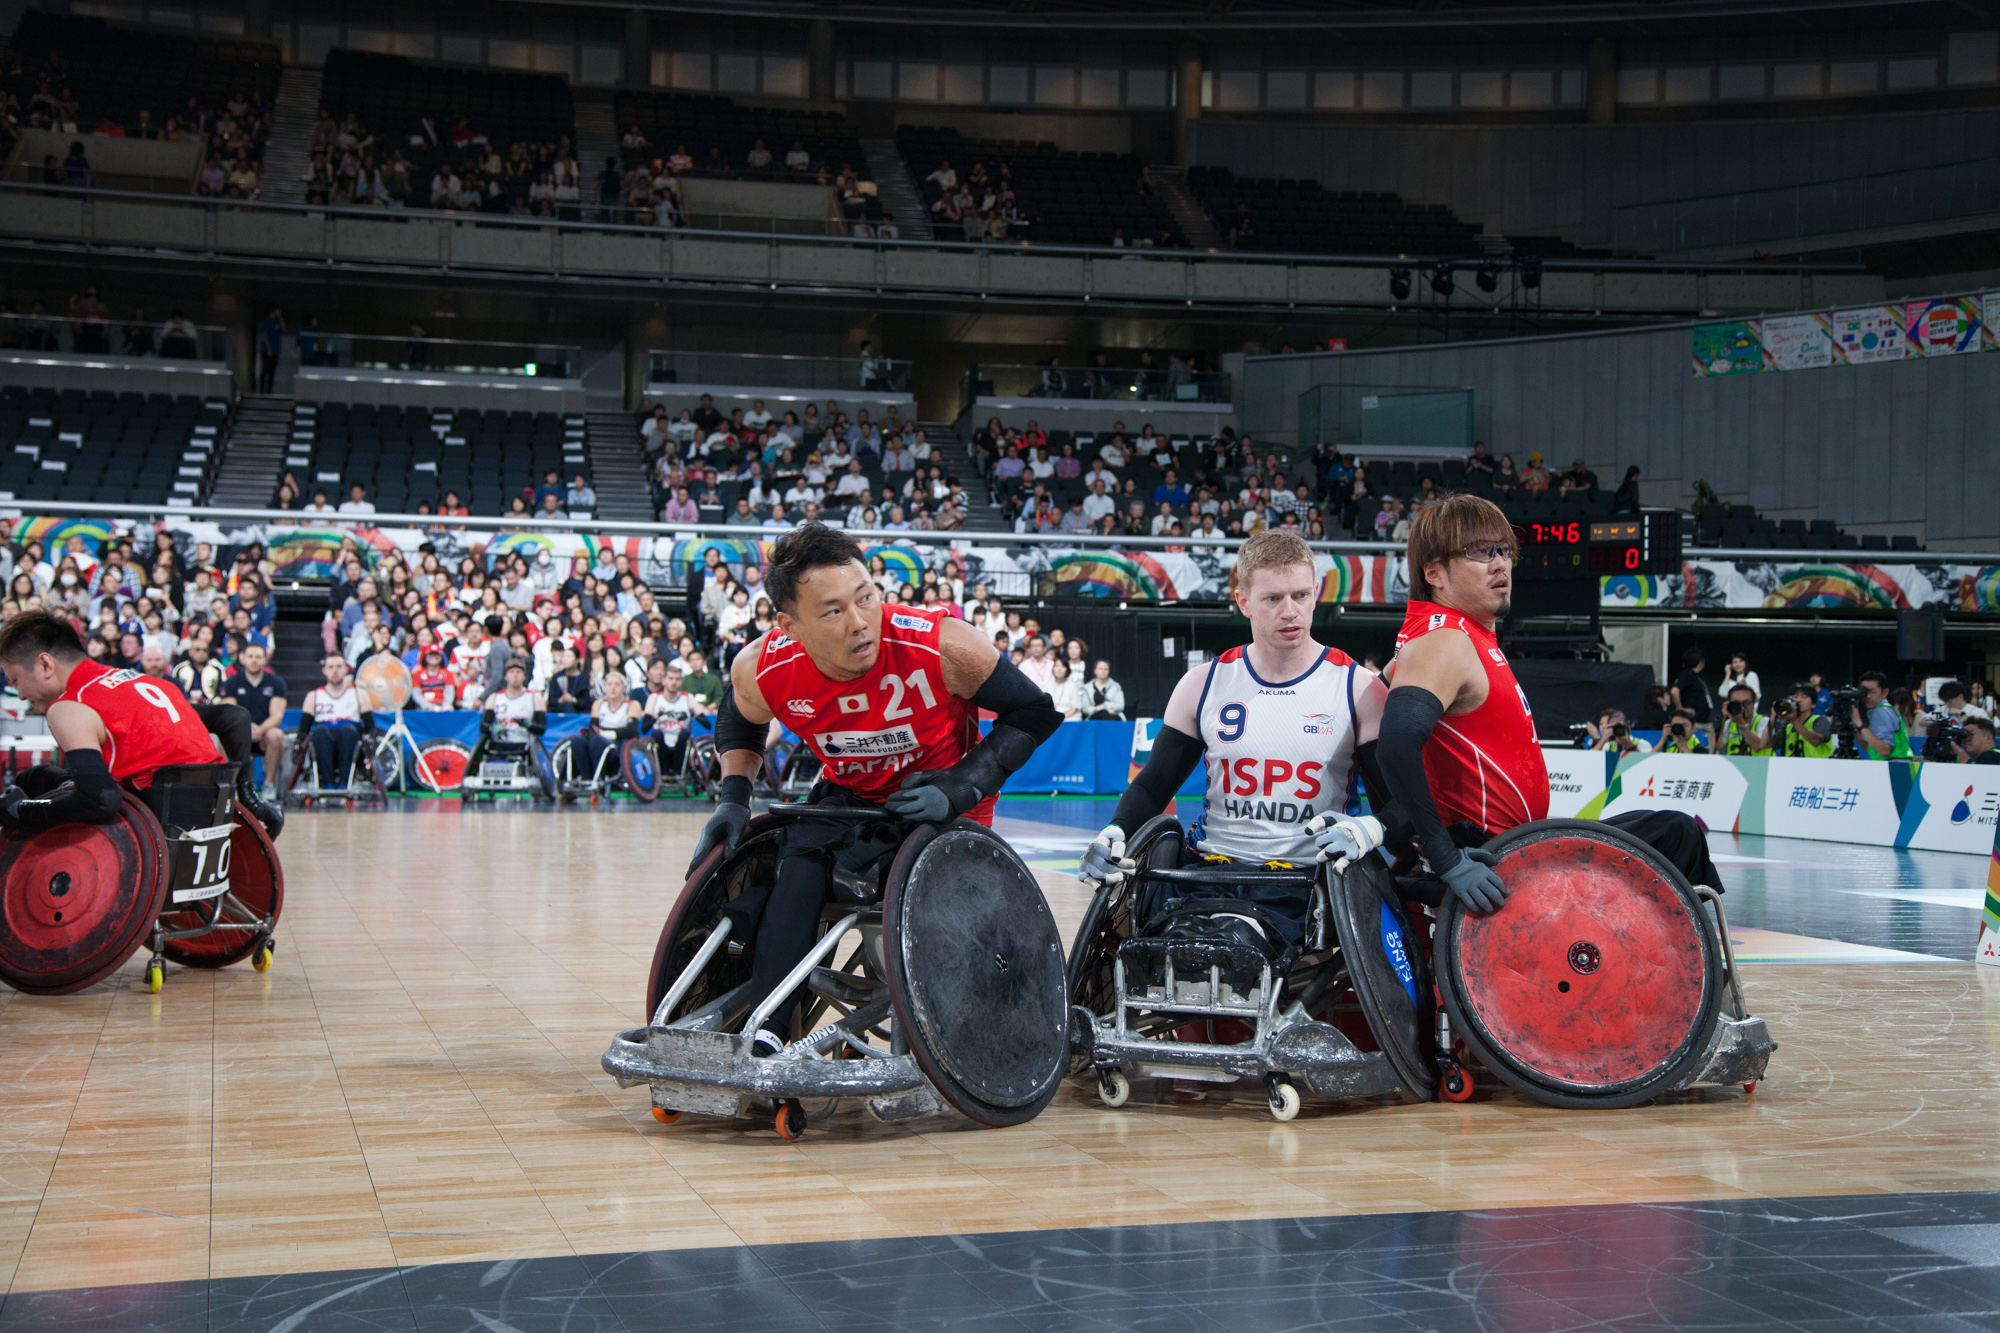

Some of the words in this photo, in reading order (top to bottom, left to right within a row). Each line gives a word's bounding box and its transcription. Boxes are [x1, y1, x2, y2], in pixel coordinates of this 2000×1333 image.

[1531, 522, 1580, 543] 7:46
[1625, 548, 1639, 569] 0
[777, 636, 791, 646] JA
[134, 682, 181, 723] 9
[880, 668, 938, 722] 21
[1216, 701, 1249, 744] 9
[1303, 725, 1334, 736] GBWR
[844, 730, 912, 749] 三井不動産
[877, 743, 914, 754] FUDOSAN
[835, 751, 924, 776] JAPAN
[1220, 757, 1324, 800] ISPS
[1550, 784, 1583, 793] RLINES
[1659, 780, 1715, 801] 三菱商事
[1788, 785, 1860, 812] 商船三井
[1224, 799, 1316, 824] HANDA
[1977, 816, 1998, 825] MITS
[192, 838, 232, 885] 1.0
[793, 1023, 839, 1052] RHINO
